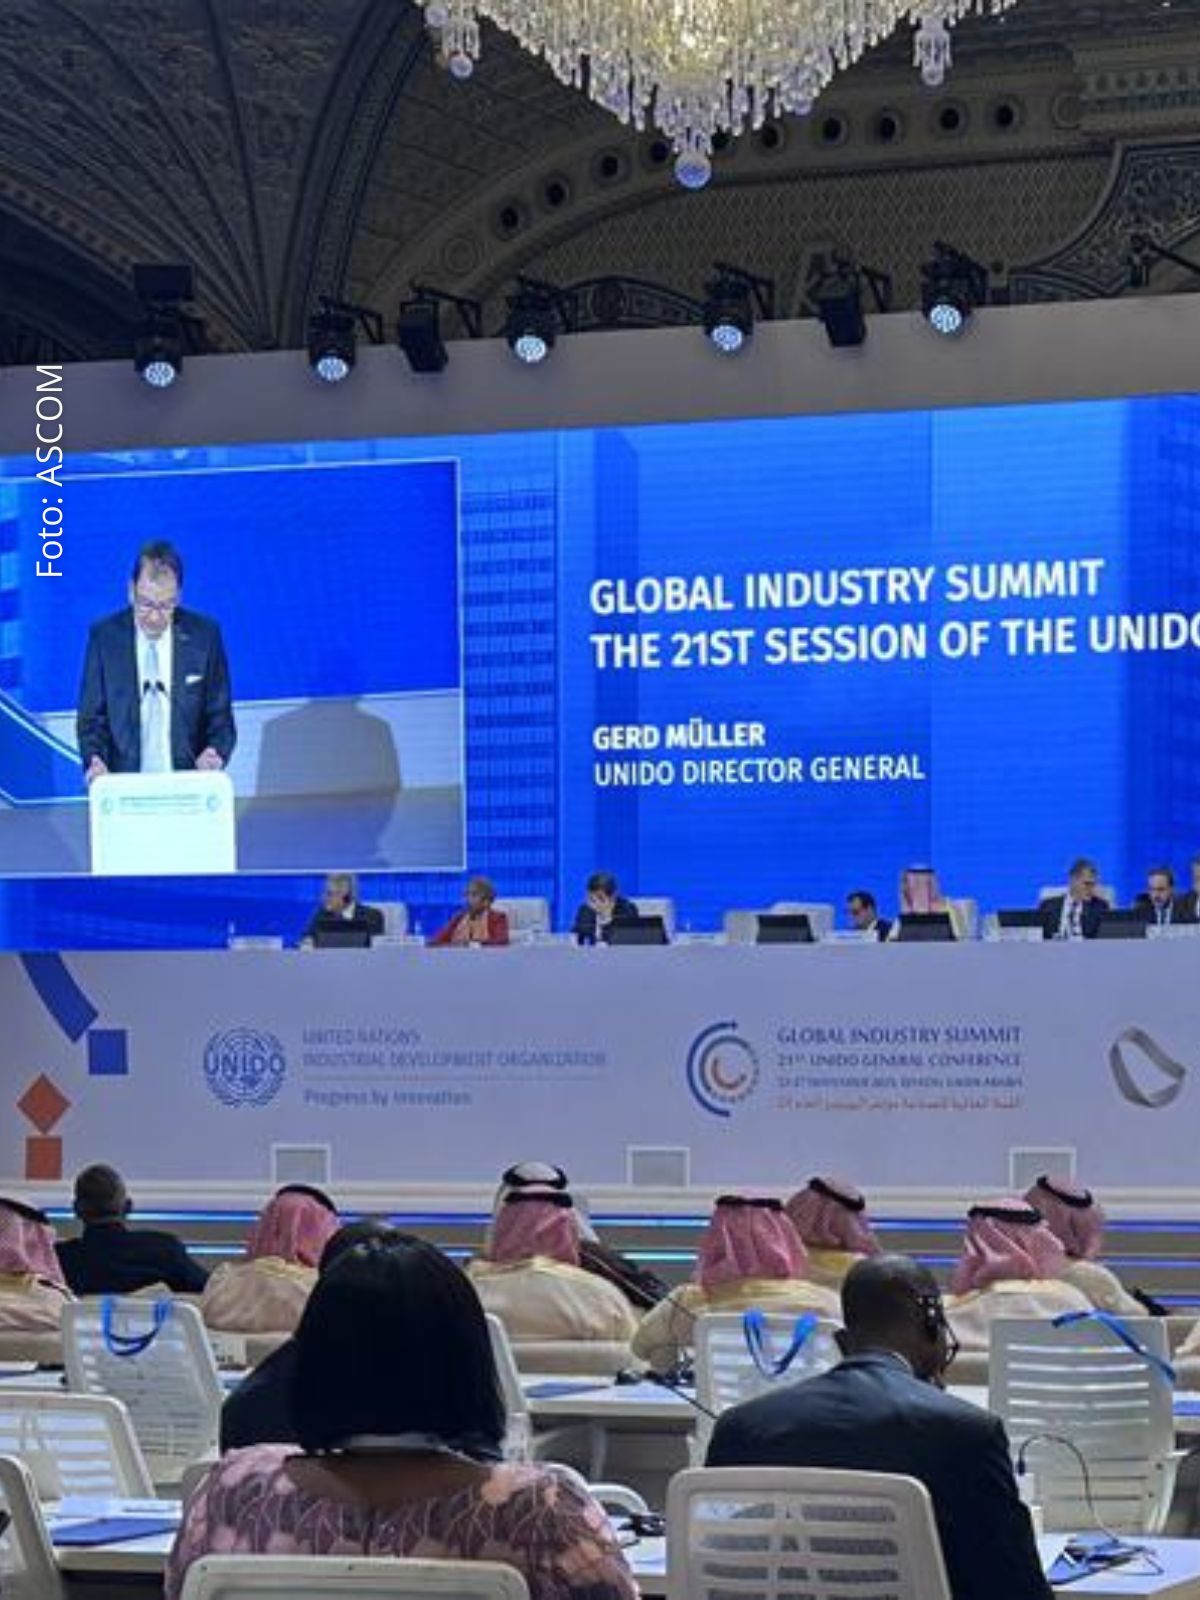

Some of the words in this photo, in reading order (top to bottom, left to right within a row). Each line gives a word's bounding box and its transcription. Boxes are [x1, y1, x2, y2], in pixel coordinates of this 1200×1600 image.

[590, 574, 733, 614] GLOBAL
[745, 565, 935, 608] INDUSTRY
[945, 558, 1105, 601] SUMMIT
[589, 633, 661, 668] THE
[671, 629, 754, 667] 21ST
[764, 623, 927, 664] SESSION
[939, 620, 990, 657] OF
[1000, 617, 1077, 655] THE
[592, 725, 660, 750] GERD
[665, 717, 766, 748] MÜLLER
[594, 759, 674, 786] UNIDO
[683, 756, 803, 785] DIRECTOR
[810, 754, 926, 781] GENERAL
[303, 1028, 352, 1045] UNITED
[777, 1027, 845, 1043] GLOBAL
[850, 1027, 941, 1043] INDUSTRY
[945, 1027, 1020, 1043] SUMMIT
[204, 1051, 286, 1076] UNIDO
[810, 1053, 859, 1067] UNIDO
[862, 1053, 923, 1067] GENERAL
[928, 1053, 1020, 1068] CONFERENCE
[303, 1089, 368, 1107] Progress
